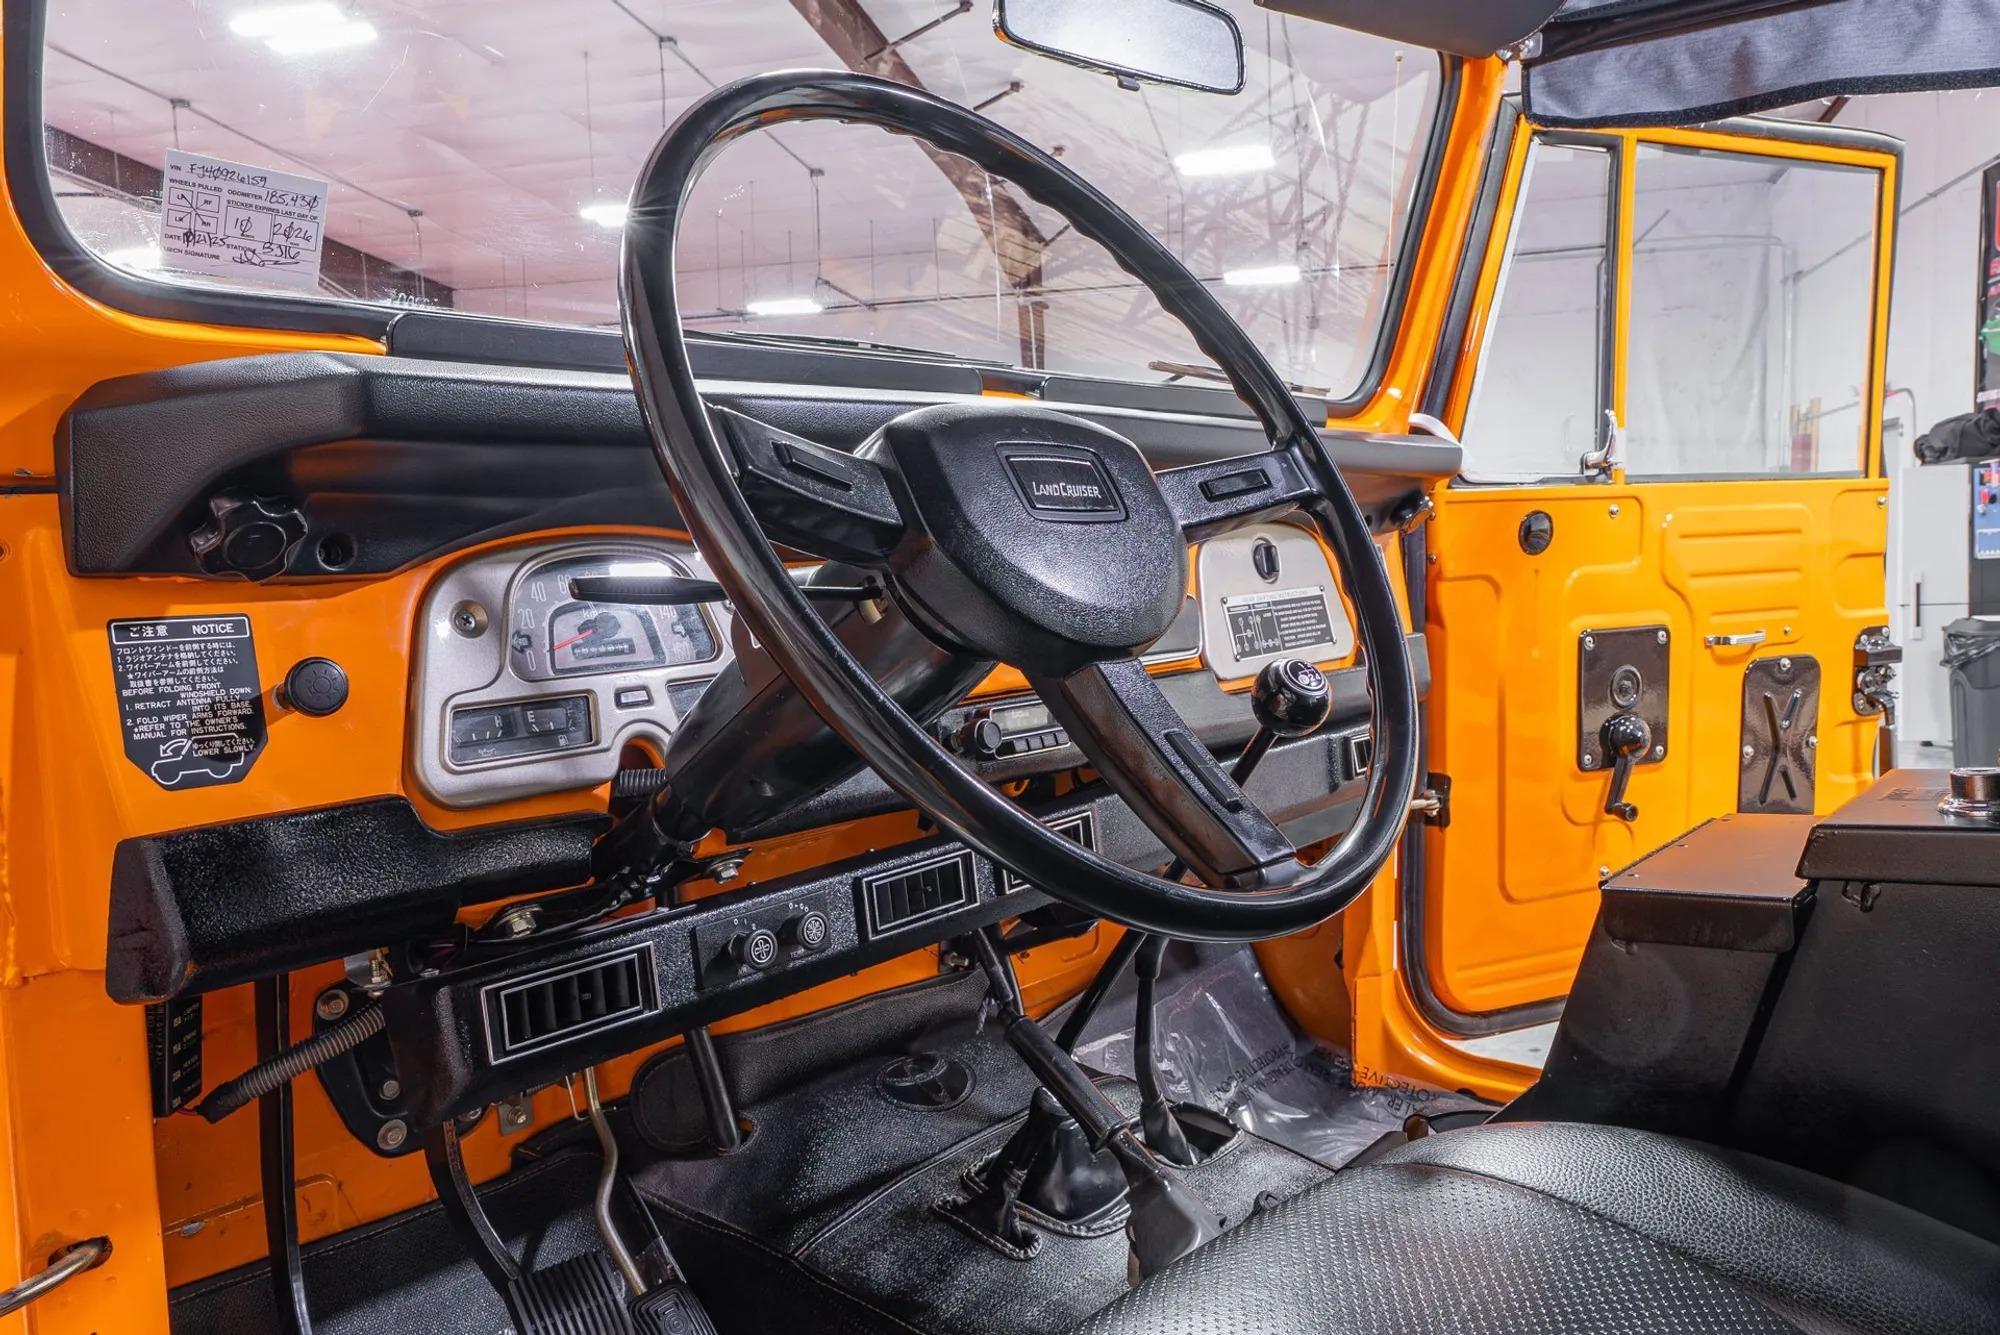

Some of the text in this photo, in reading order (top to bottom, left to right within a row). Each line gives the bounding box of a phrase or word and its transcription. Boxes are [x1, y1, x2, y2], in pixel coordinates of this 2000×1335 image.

[169, 178, 222, 193] WHEELS PULLED
[228, 189, 262, 200] ODOMETER
[227, 200, 253, 209] STICKER
[255, 204, 280, 213] EXPIRES
[184, 250, 220, 260] SIGNATURE
[531, 581, 547, 603] 40
[518, 608, 535, 629] 20
[130, 625, 168, 637] ご注意
[192, 623, 234, 634] NOTICE
[526, 651, 536, 671] 0
[122, 687, 154, 696] BEFORE
[159, 685, 192, 693] FOLDING
[180, 689, 226, 698] WINDSHIELD
[135, 700, 171, 710] RETRACT
[177, 697, 211, 706] ANTENNA
[137, 716, 158, 724] FOLD
[163, 714, 187, 722] WIPER
[192, 711, 213, 719] ARMS
[205, 716, 238, 725] OWNER'S
[494, 716, 502, 727] H
[527, 711, 535, 722] E
[134, 731, 167, 740] MANUAL
[193, 748, 219, 757] LOWER
